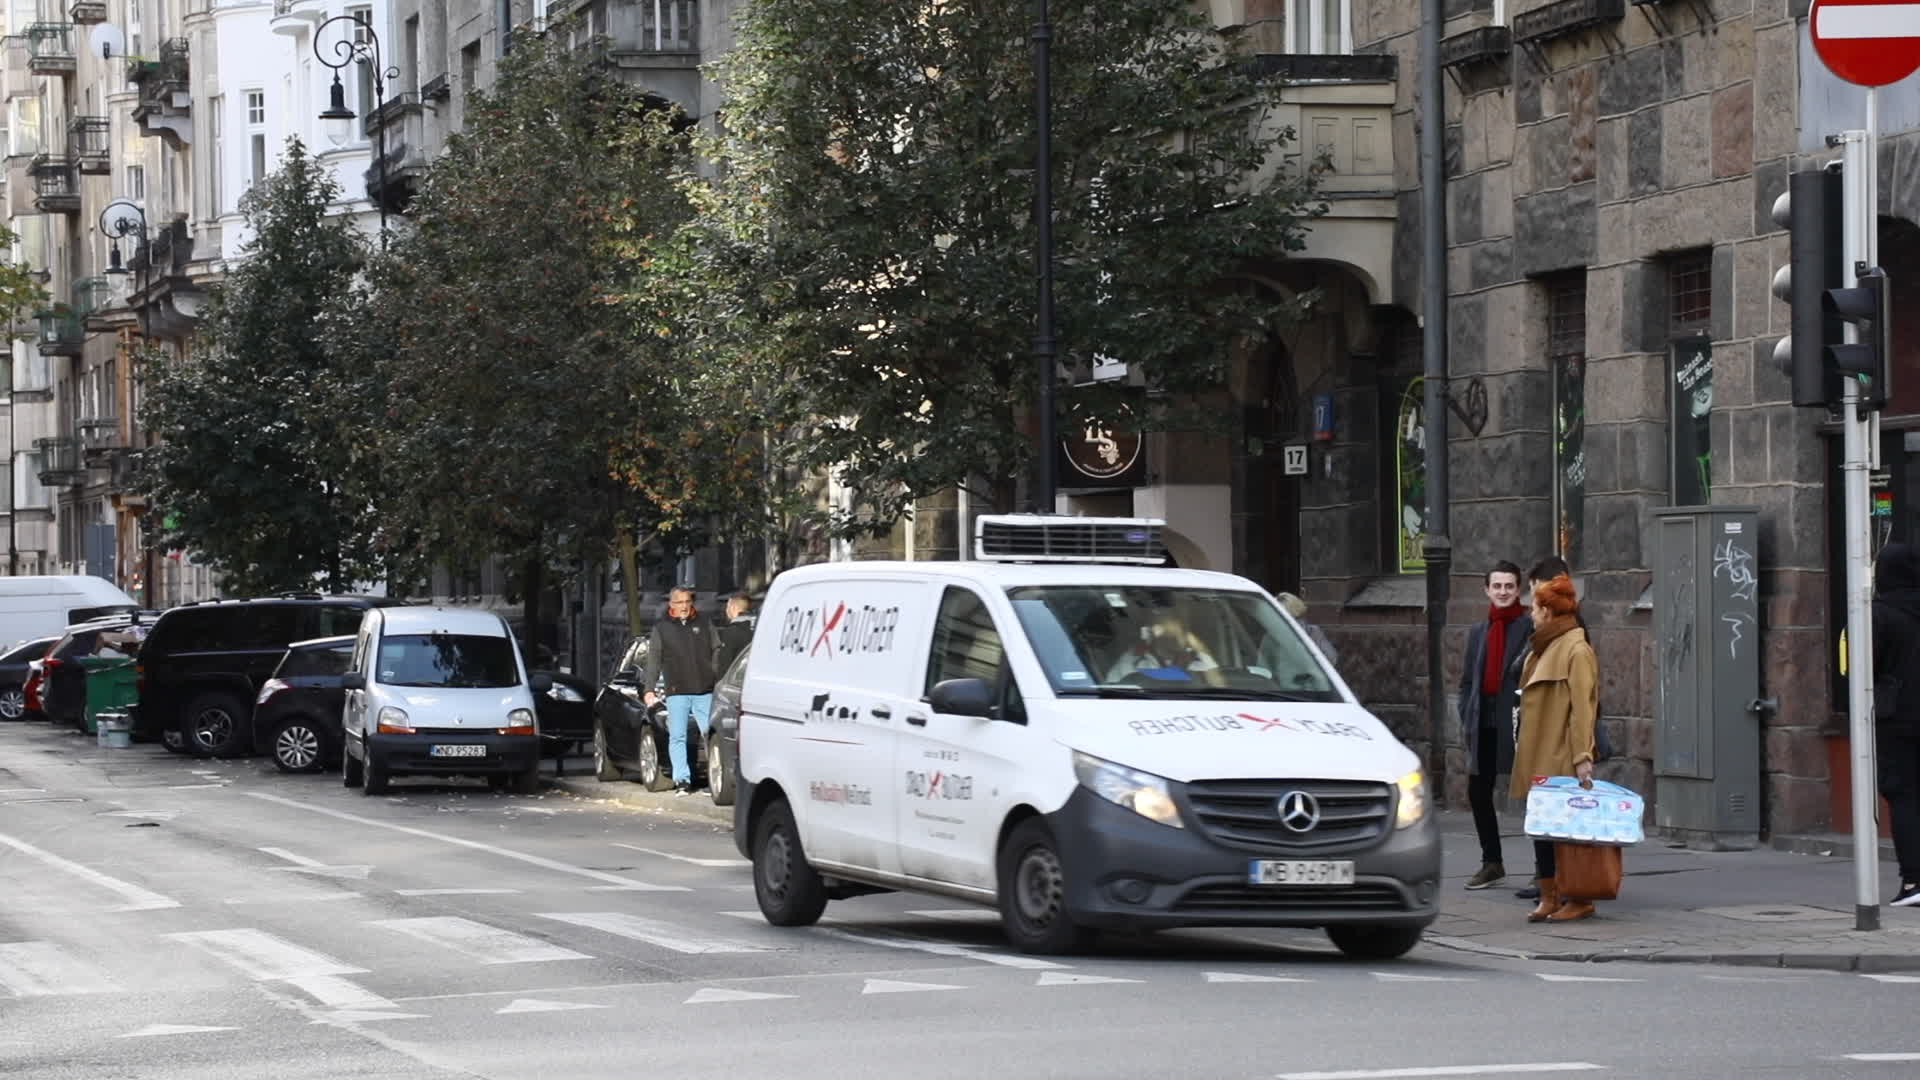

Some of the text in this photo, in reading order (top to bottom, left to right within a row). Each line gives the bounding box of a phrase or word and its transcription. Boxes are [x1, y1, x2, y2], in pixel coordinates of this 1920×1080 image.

[1287, 449, 1304, 465] 17
[780, 604, 900, 655] CRAZY BUTCHER
[456, 746, 486, 757] 95283
